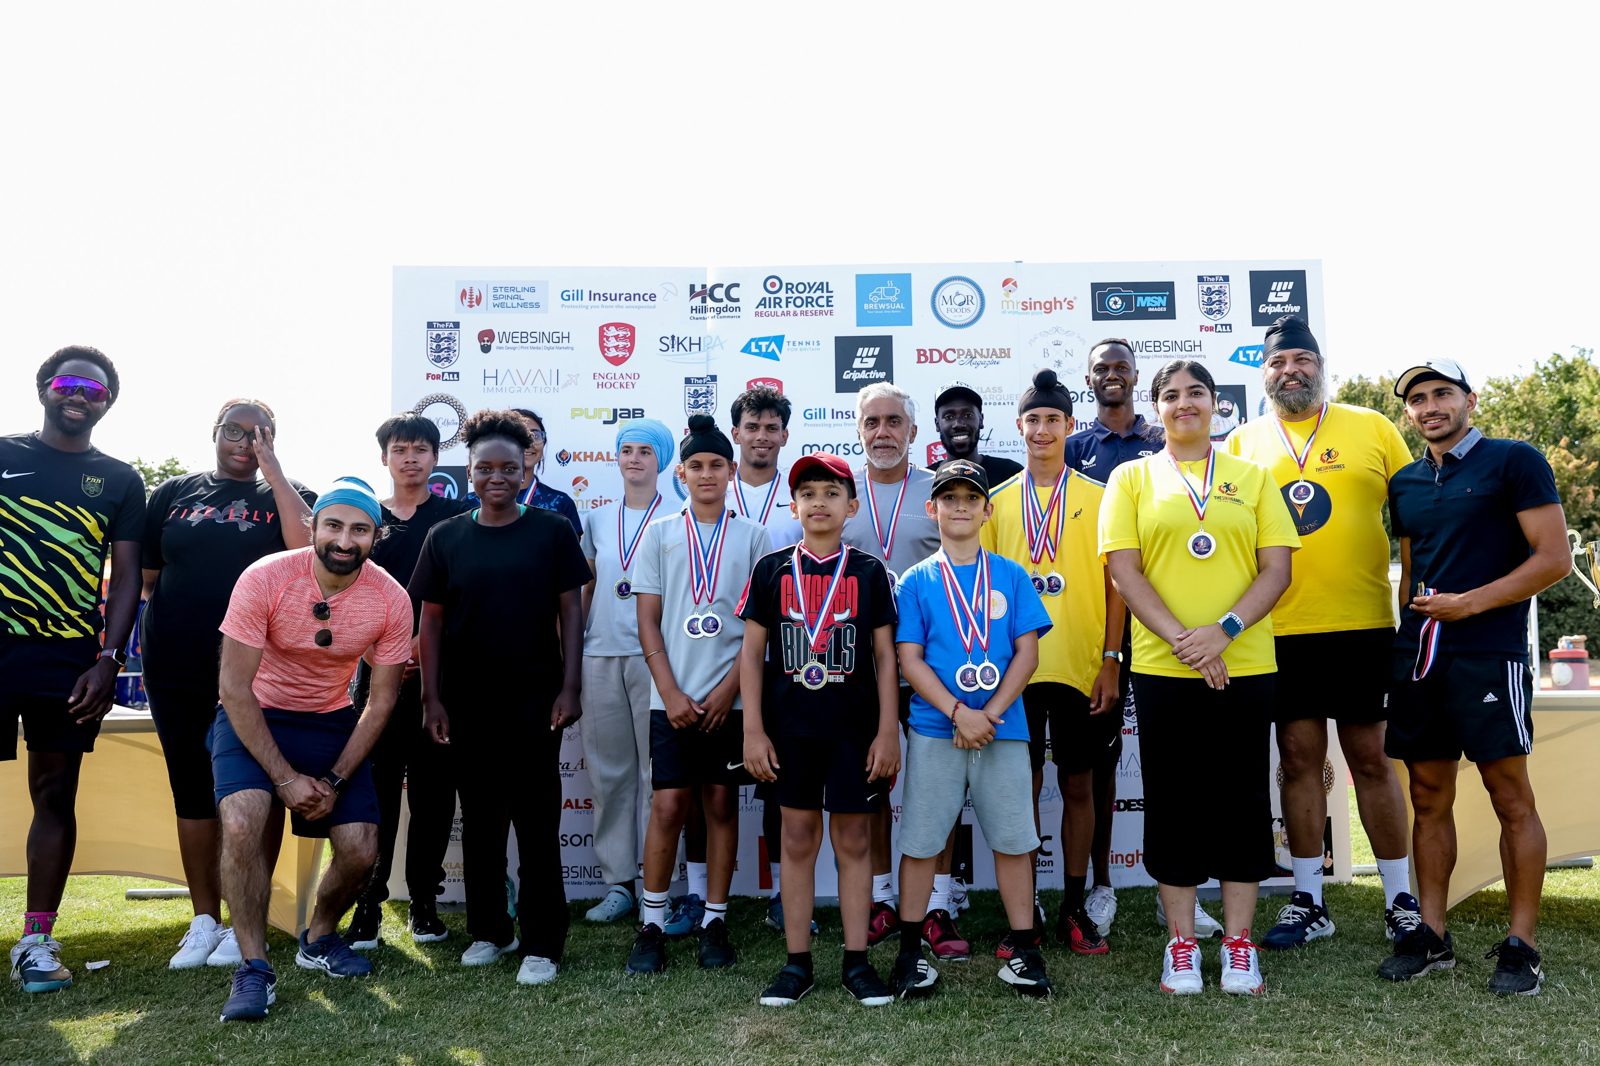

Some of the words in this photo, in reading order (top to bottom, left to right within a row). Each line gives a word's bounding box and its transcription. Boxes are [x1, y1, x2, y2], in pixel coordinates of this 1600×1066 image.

[689, 282, 741, 304] HCC
[785, 281, 834, 295] ROYAL
[560, 289, 584, 302] Gill
[588, 289, 657, 302] Insurance
[755, 296, 783, 309] AIR
[785, 295, 834, 308] FORCE
[1136, 296, 1167, 307] MSN
[690, 304, 741, 315] Hillingdon
[754, 310, 791, 318] REGULAR
[799, 309, 834, 317] RESERVE
[1258, 303, 1301, 315] GripActive
[497, 331, 570, 344] WEBSINGH
[751, 340, 781, 358] LTA
[1130, 340, 1202, 353] WEBSINGH
[916, 348, 957, 364] BDC
[956, 347, 1011, 359] PANJABI
[592, 372, 641, 381] ENGLAND
[842, 369, 886, 381] GripActive
[596, 381, 637, 389] HOCKEY
[803, 408, 826, 420] Gill
[228, 508, 274, 524] LILY
[781, 622, 856, 673] BULS
